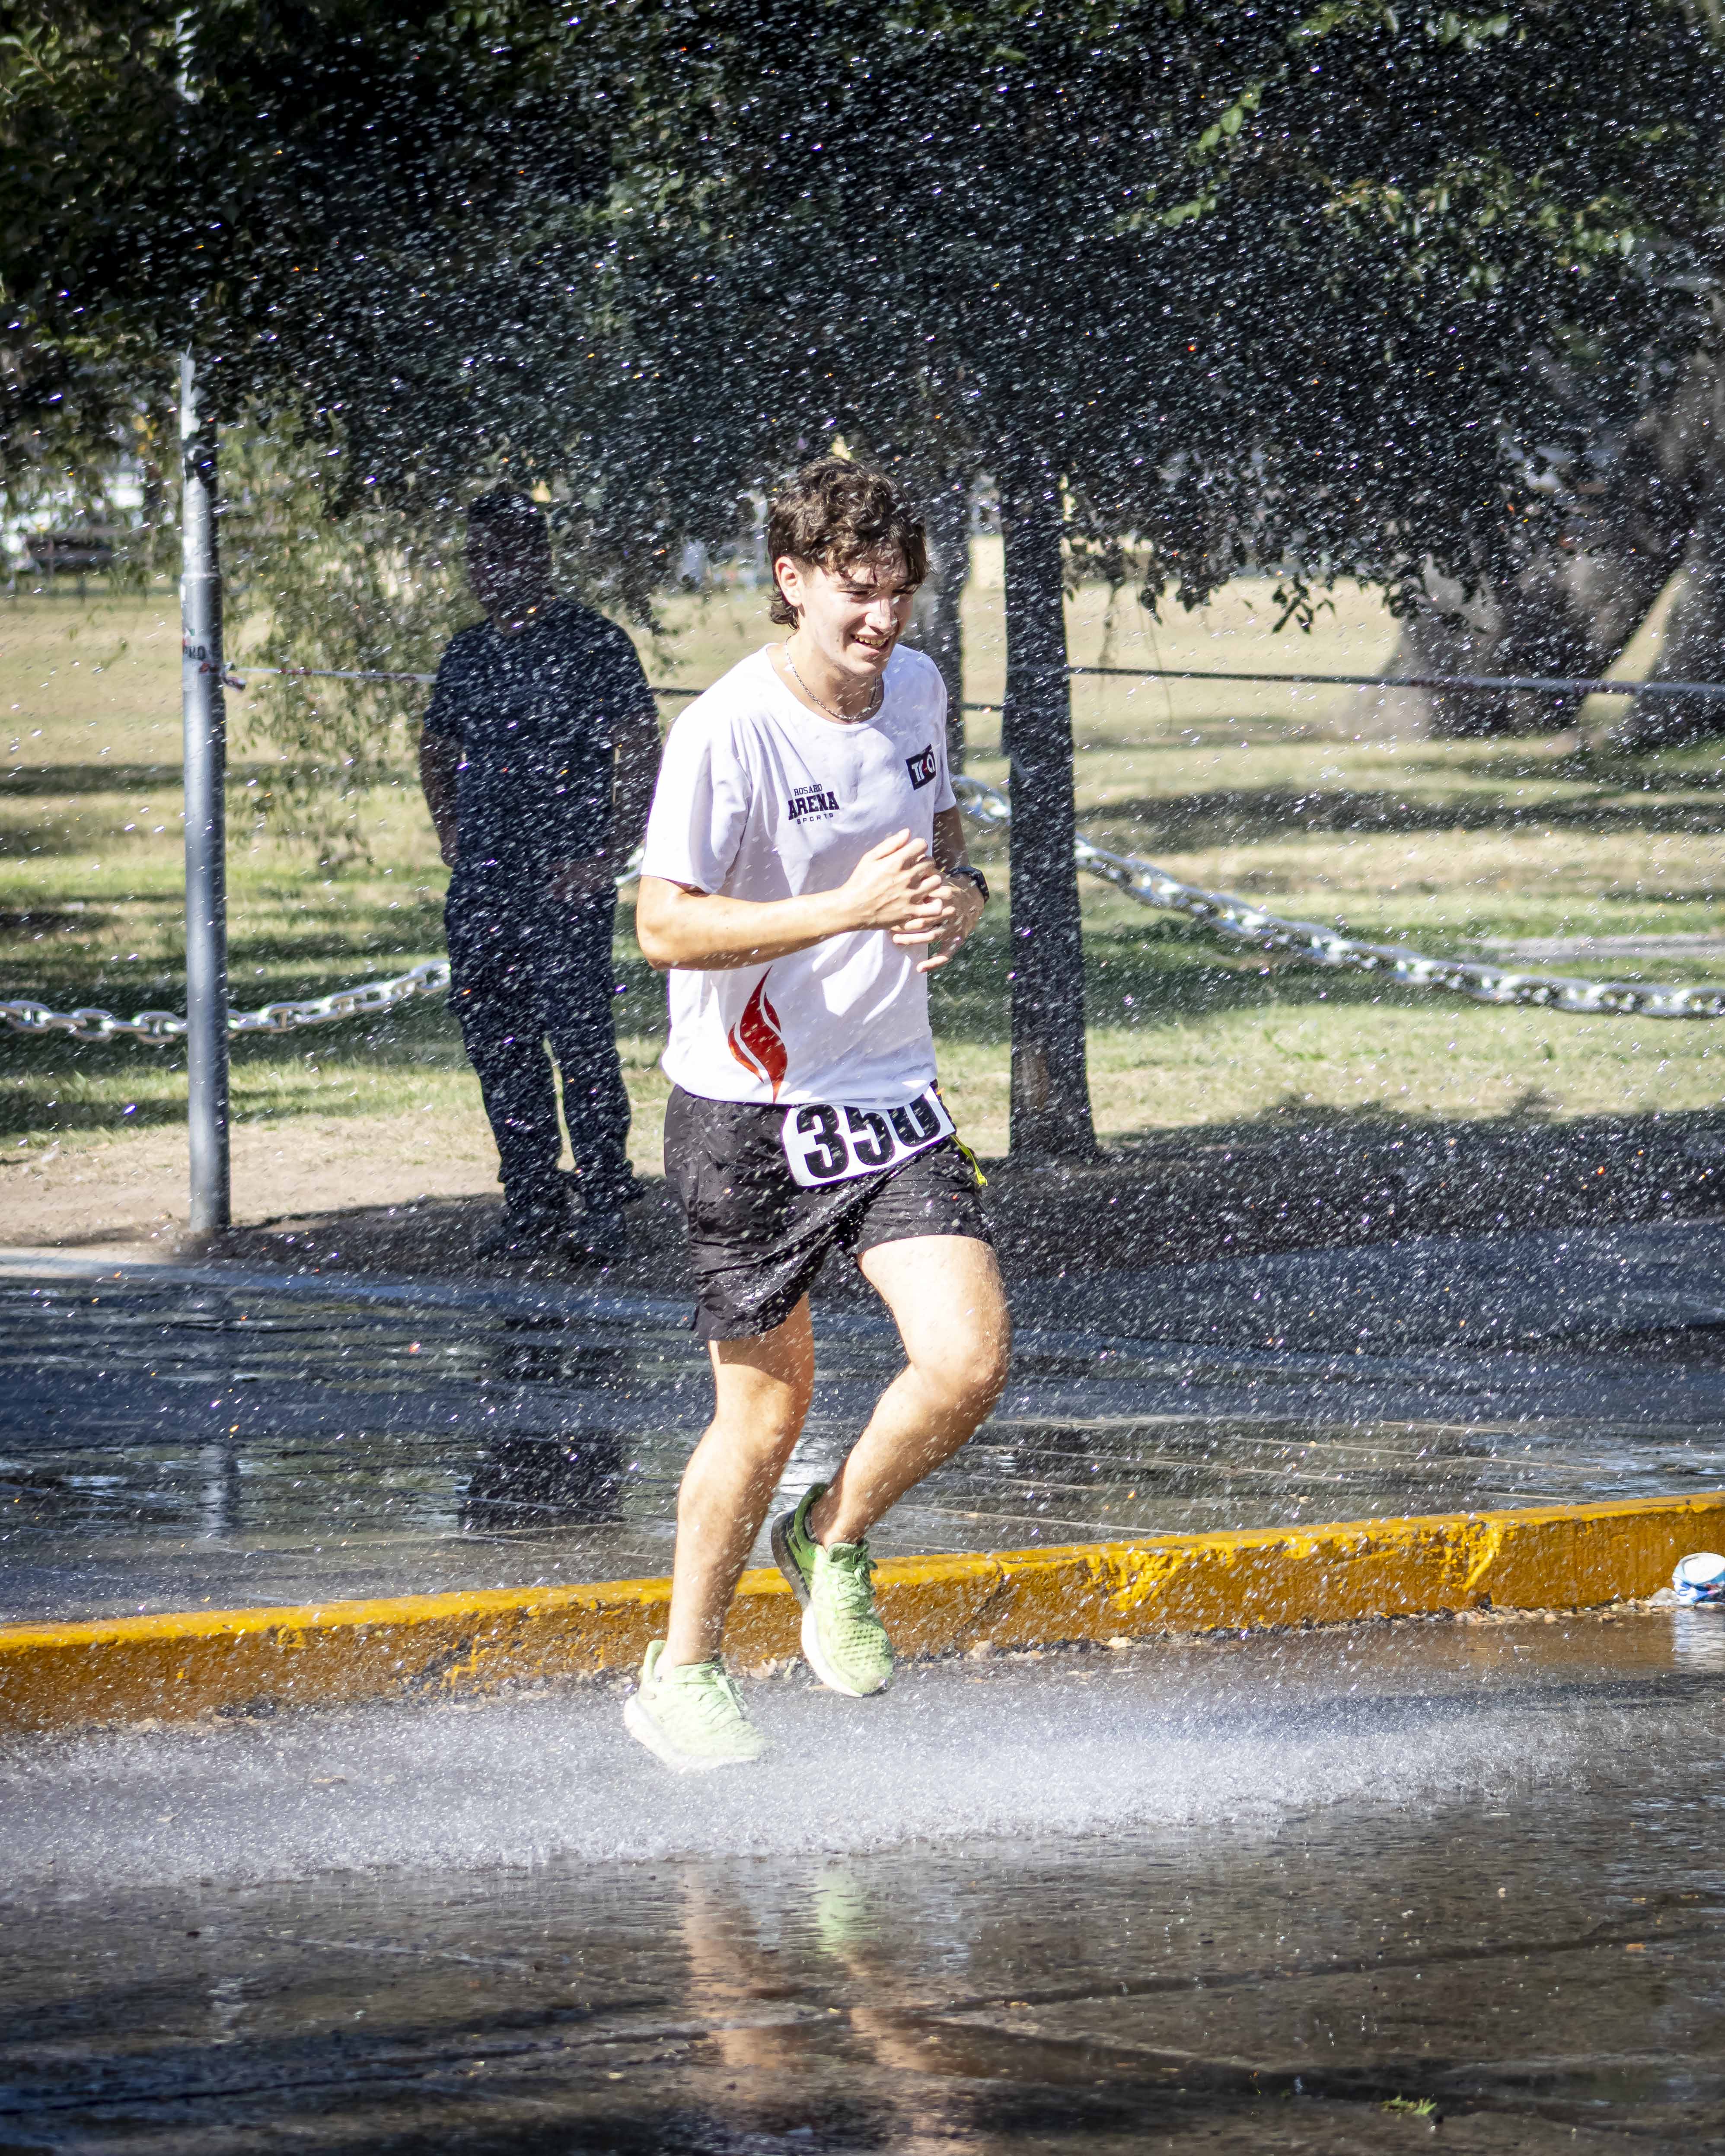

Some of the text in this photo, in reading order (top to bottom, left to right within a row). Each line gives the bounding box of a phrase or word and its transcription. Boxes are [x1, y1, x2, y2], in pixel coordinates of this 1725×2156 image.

[788, 791, 840, 820] ARENA
[797, 812, 834, 825] SPORTS
[796, 1093, 941, 1178] 350
